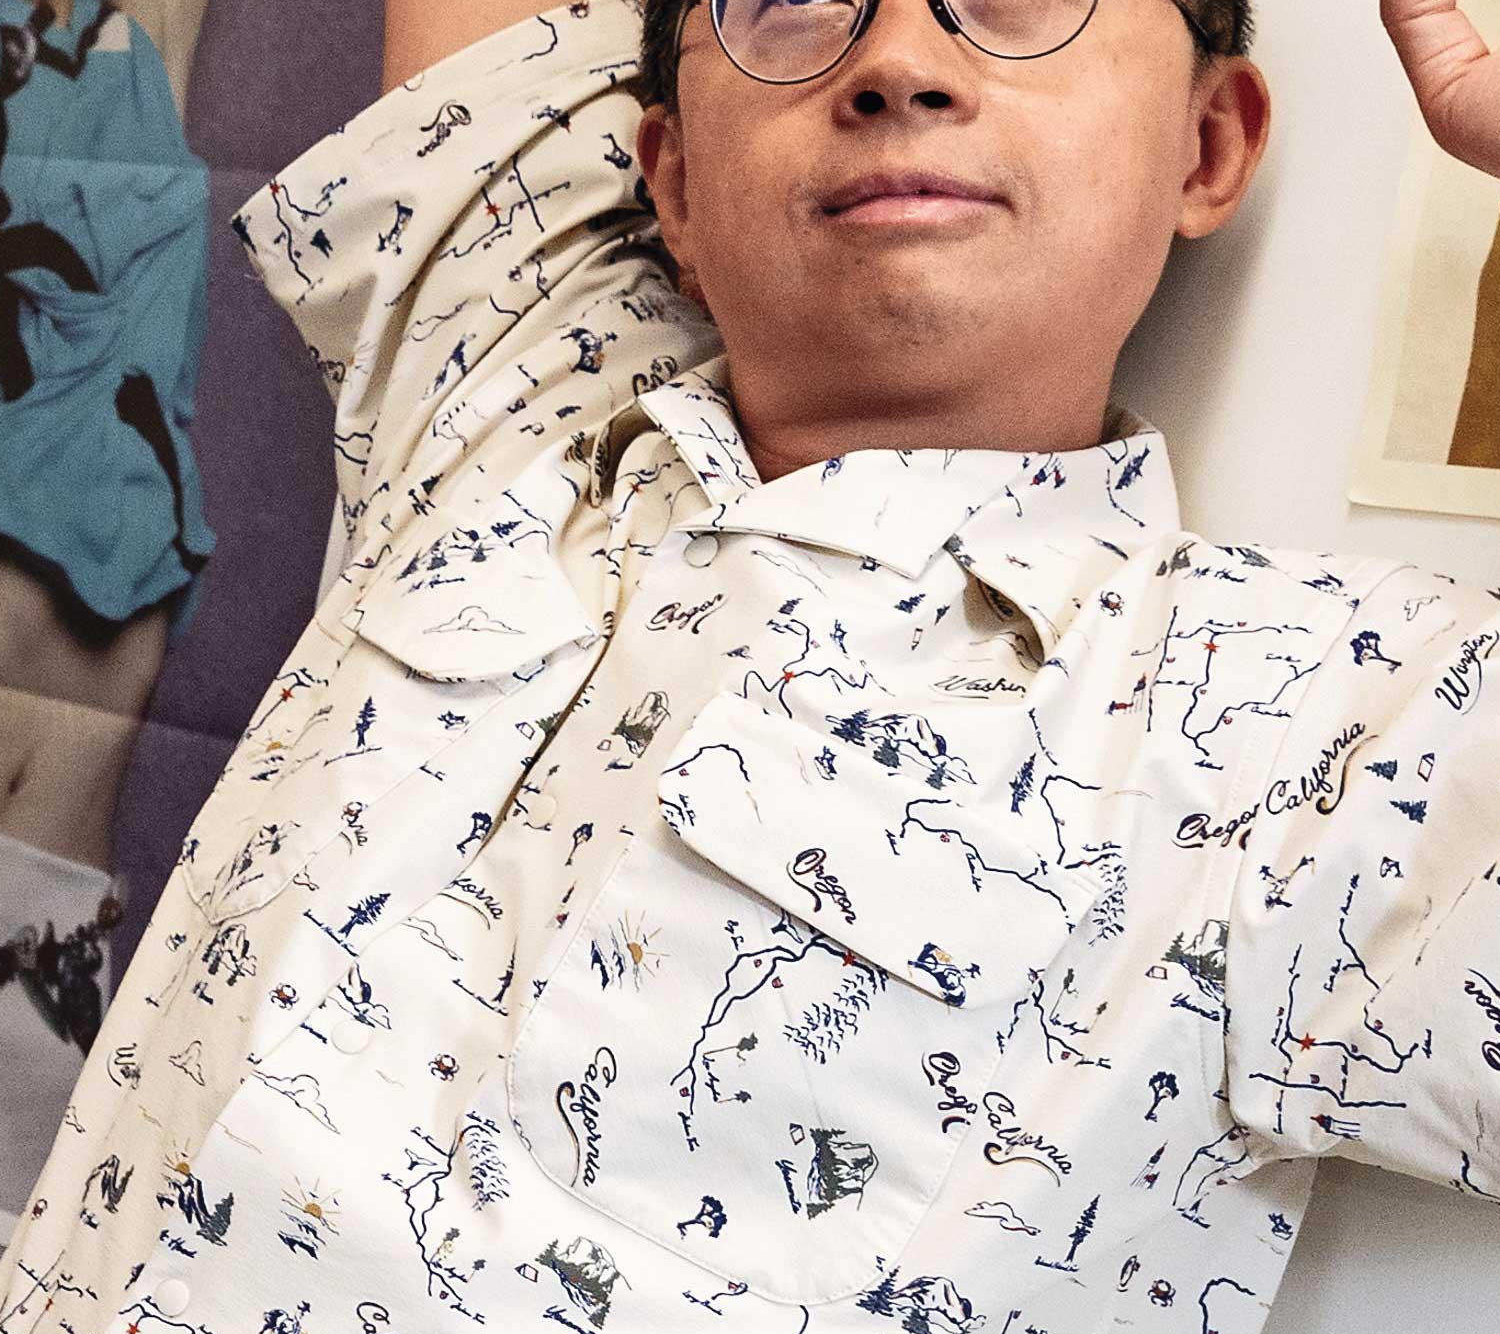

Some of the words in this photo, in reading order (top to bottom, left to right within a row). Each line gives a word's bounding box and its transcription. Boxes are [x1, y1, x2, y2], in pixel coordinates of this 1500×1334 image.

[929, 674, 1027, 701] Washin
[1266, 722, 1366, 816] California
[790, 846, 857, 925] Oregon
[572, 1046, 617, 1188] California
[983, 1091, 1073, 1176] California
